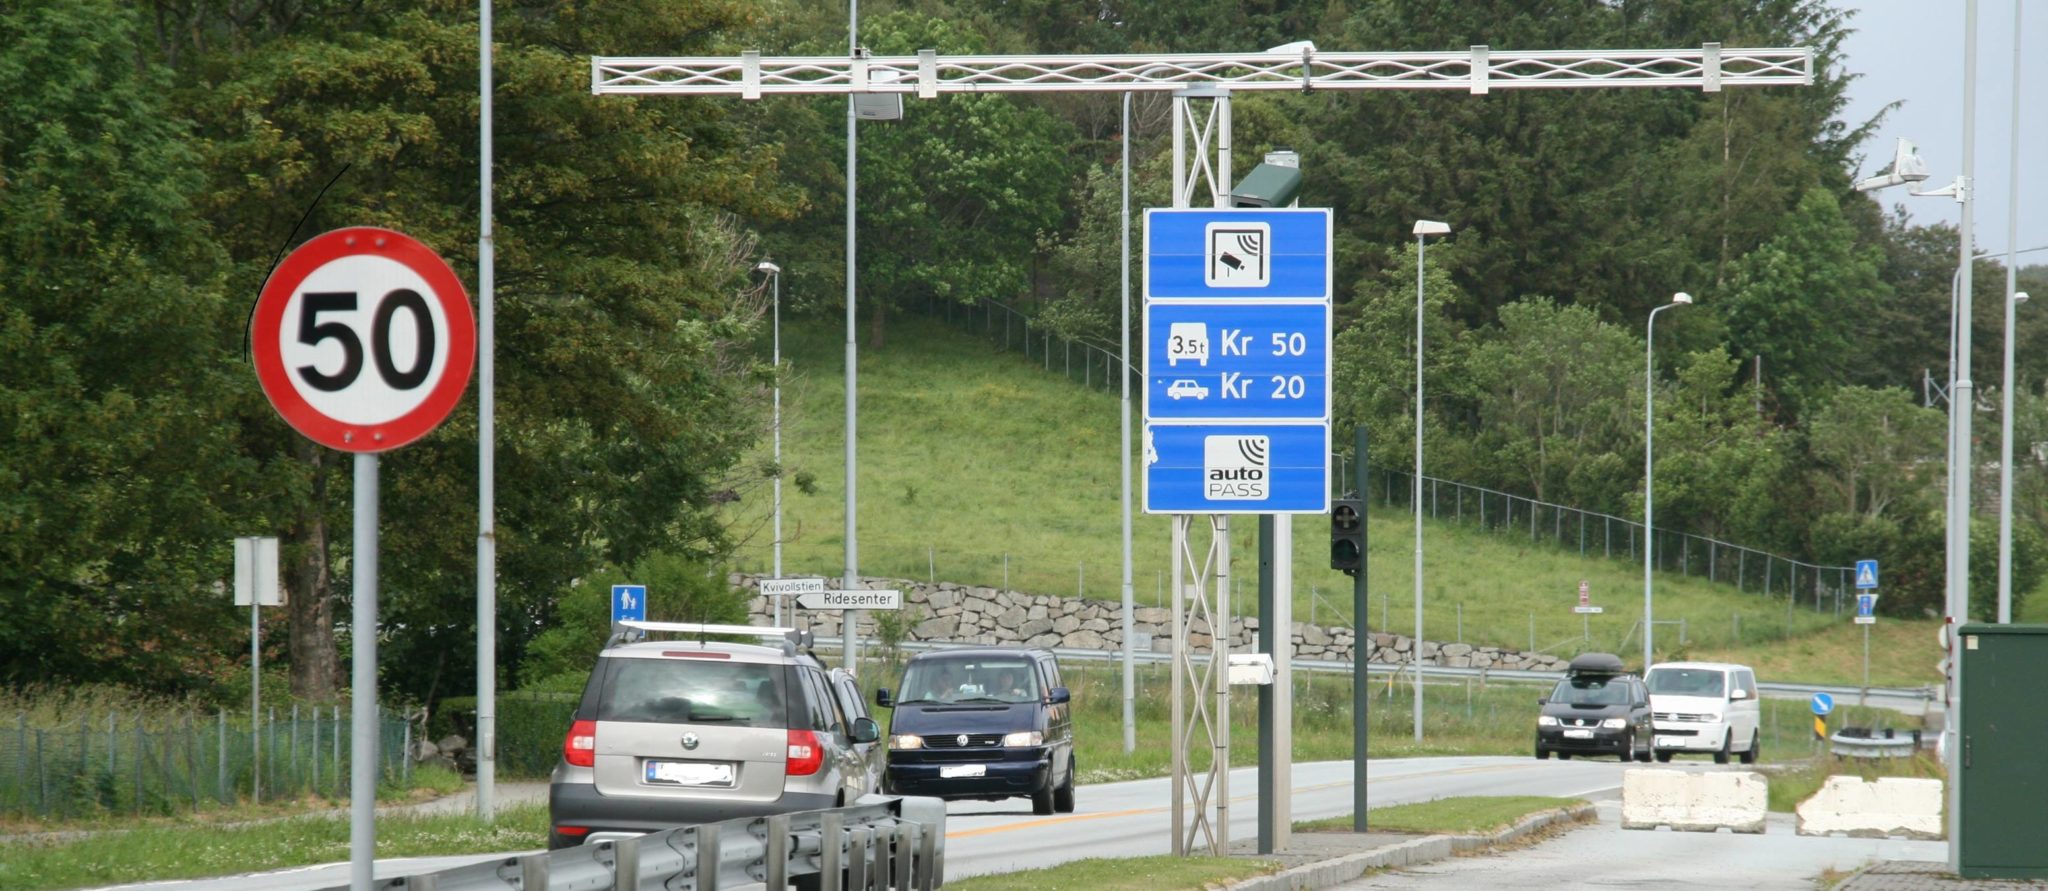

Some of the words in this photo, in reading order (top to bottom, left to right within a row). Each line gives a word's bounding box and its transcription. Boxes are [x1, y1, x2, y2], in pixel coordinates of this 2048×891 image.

[296, 287, 436, 393] 50
[1221, 329, 1254, 356] Kr
[1271, 331, 1306, 356] 50
[1221, 372, 1254, 399] Kr
[1271, 375, 1305, 399] 20
[1209, 466, 1263, 481] auto
[1209, 483, 1263, 497] PASS
[763, 582, 821, 592] Kvivollstien
[824, 593, 892, 605] Ridesenter
